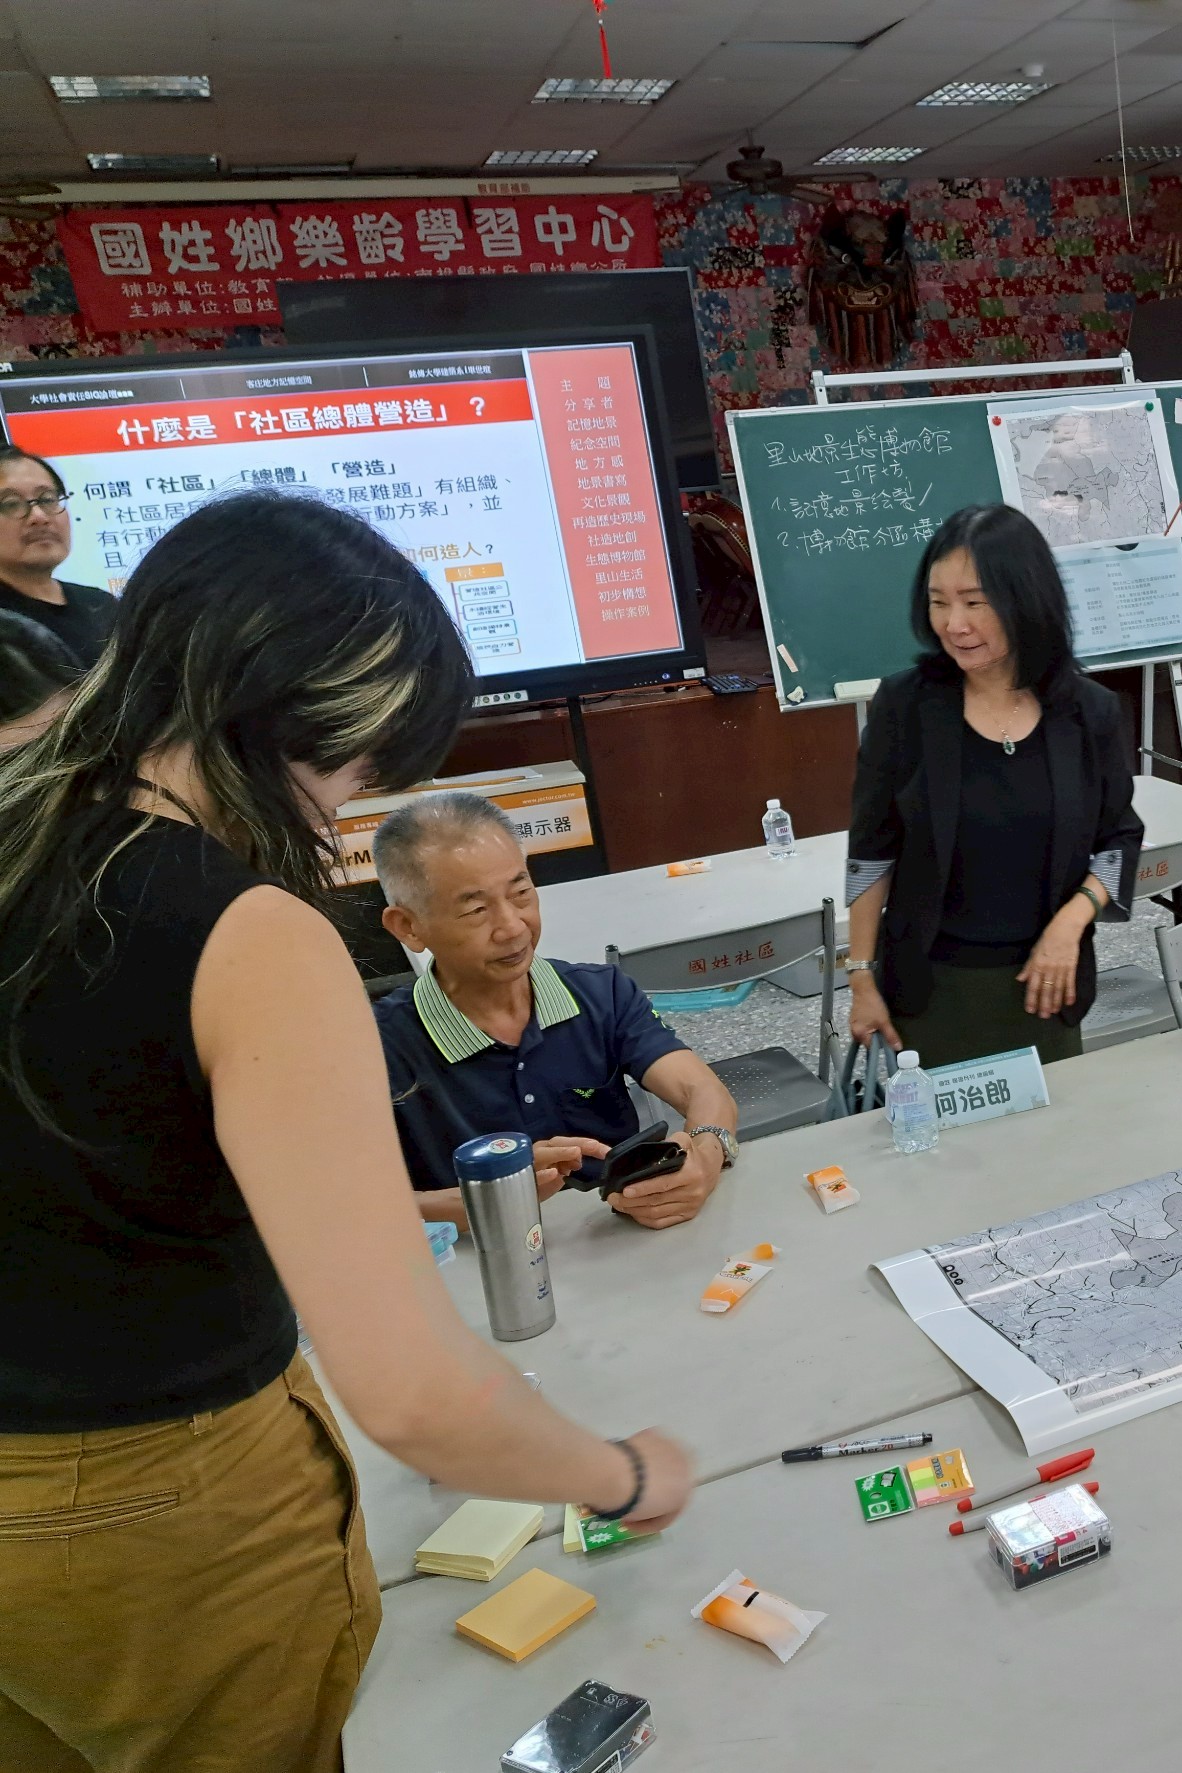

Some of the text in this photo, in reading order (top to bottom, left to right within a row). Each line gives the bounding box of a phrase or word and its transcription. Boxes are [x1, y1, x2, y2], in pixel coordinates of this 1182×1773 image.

[90, 204, 634, 276] 國姓鄉樂齡學習中心
[121, 277, 293, 299] 補助單位:教育
[567, 416, 617, 432] 記憶地景
[570, 435, 620, 451] 紀念空間
[578, 474, 627, 490] 地景書寫
[582, 493, 631, 509] 文化景觀
[571, 511, 646, 529] 再造歷史現場
[586, 549, 646, 566] 生態博物館
[595, 568, 643, 585] 里山生活
[598, 586, 647, 603] 初步構想
[601, 605, 650, 621] 操作案例
[688, 940, 775, 975] 國姓社區
